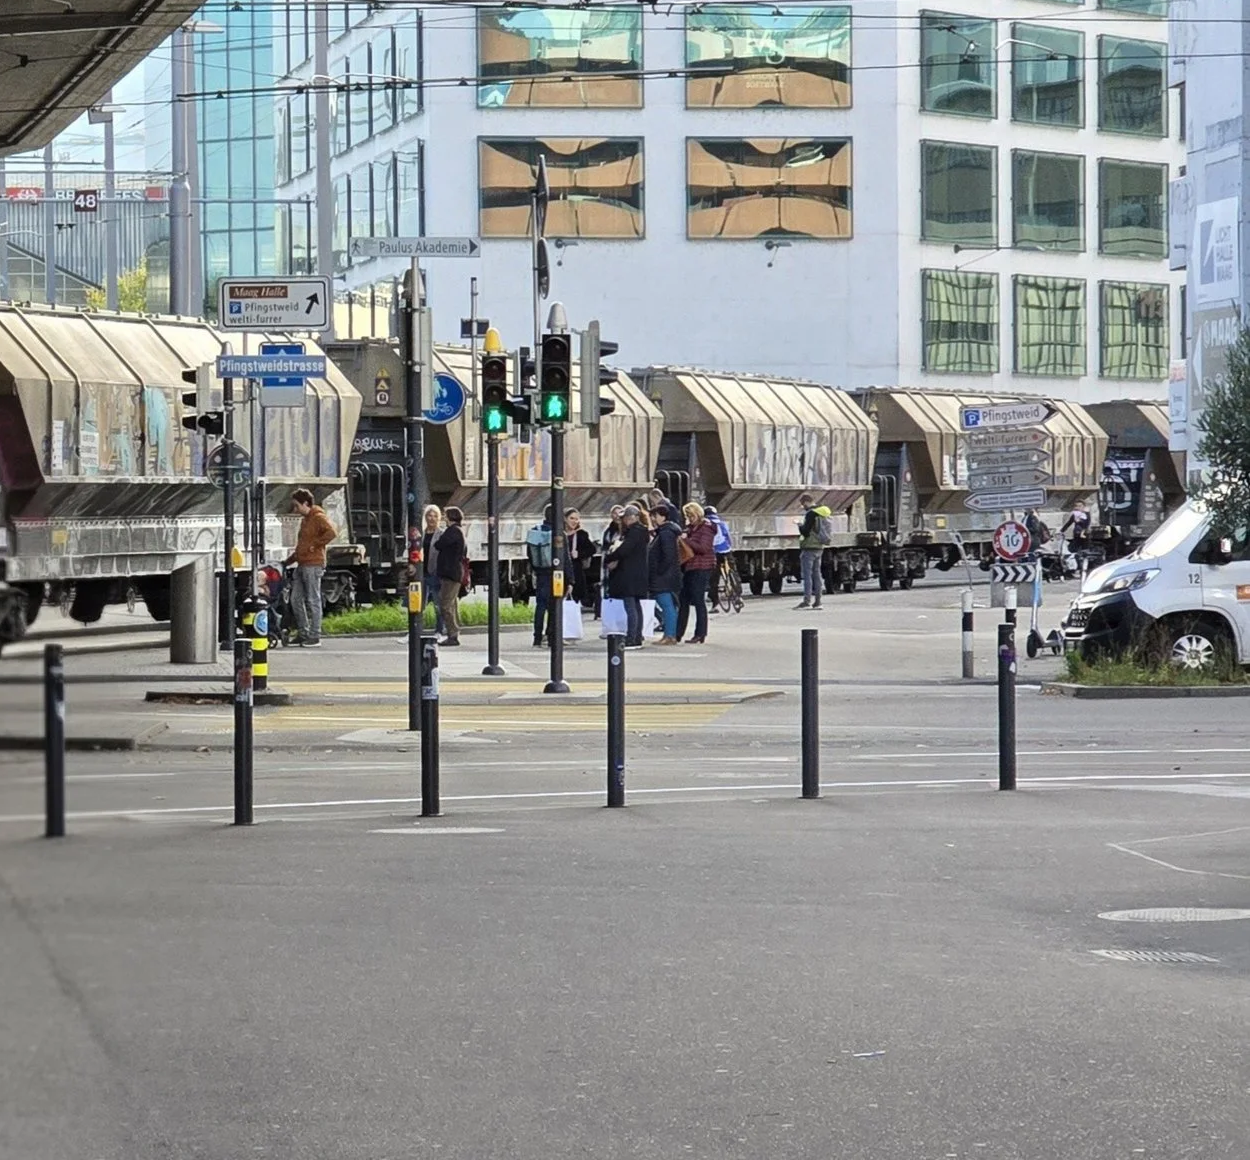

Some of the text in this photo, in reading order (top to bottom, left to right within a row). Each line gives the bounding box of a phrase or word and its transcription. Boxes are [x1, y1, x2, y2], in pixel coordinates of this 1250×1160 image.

[75, 194, 96, 208] 48
[379, 240, 468, 254] Paulus Akademie
[232, 286, 287, 299] Maag Halle
[244, 302, 300, 316] Pfingstweid
[229, 315, 283, 325] welti-furrer
[220, 359, 324, 376] Pfingstweidstrasse
[982, 406, 1040, 424] Pfingstweid
[991, 475, 1013, 486] SIXT
[1188, 573, 1201, 584] 12
